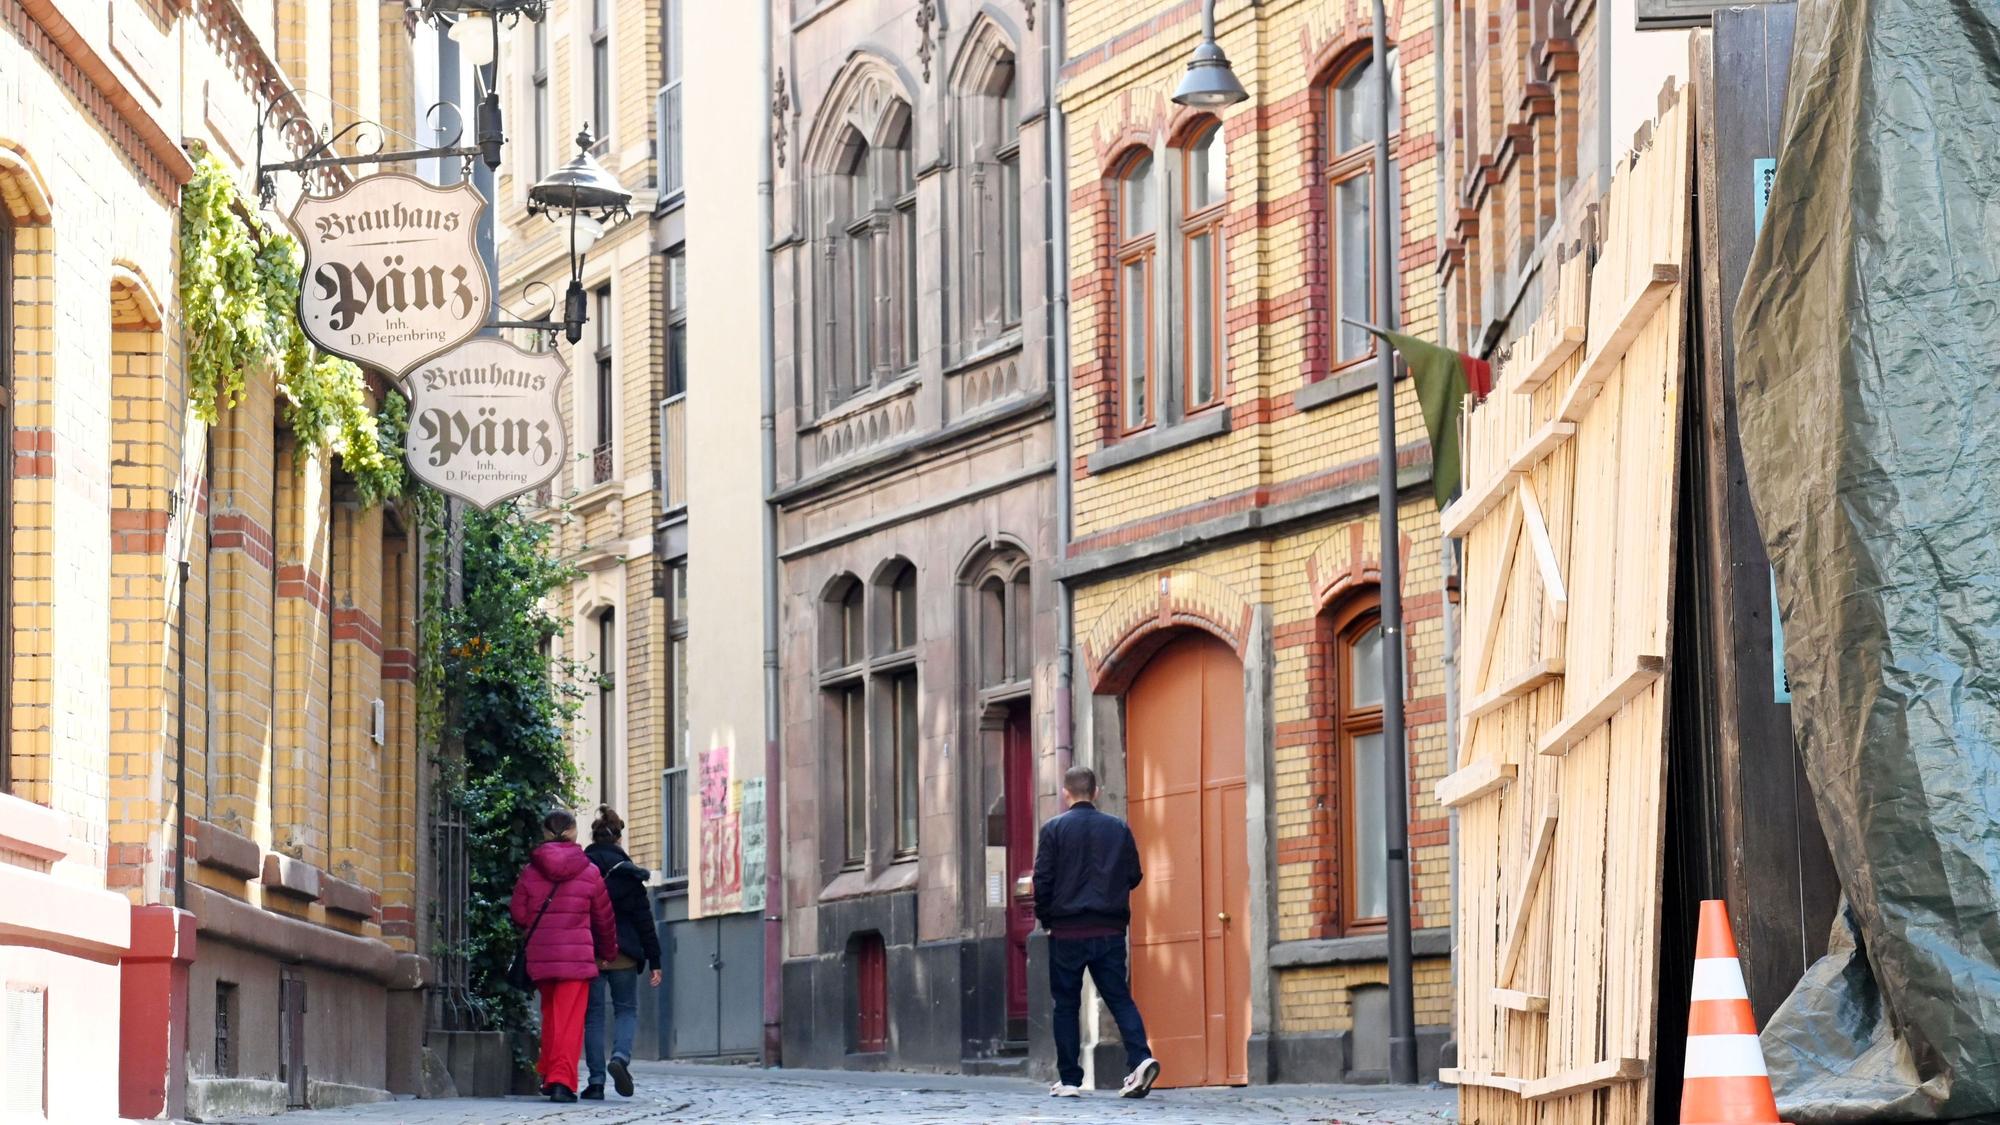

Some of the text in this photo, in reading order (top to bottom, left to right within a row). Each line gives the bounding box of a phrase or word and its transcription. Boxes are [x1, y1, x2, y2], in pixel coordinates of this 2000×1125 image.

[315, 202, 461, 243] Brauhaus
[313, 255, 474, 331] Pänz
[386, 319, 409, 330] Inh.
[351, 329, 446, 347] D. Piepenbring
[423, 362, 547, 392] Brauhaus
[415, 407, 553, 467] Pänz
[446, 471, 528, 484] D. Piepenbring
[477, 460, 497, 471] Inh.
